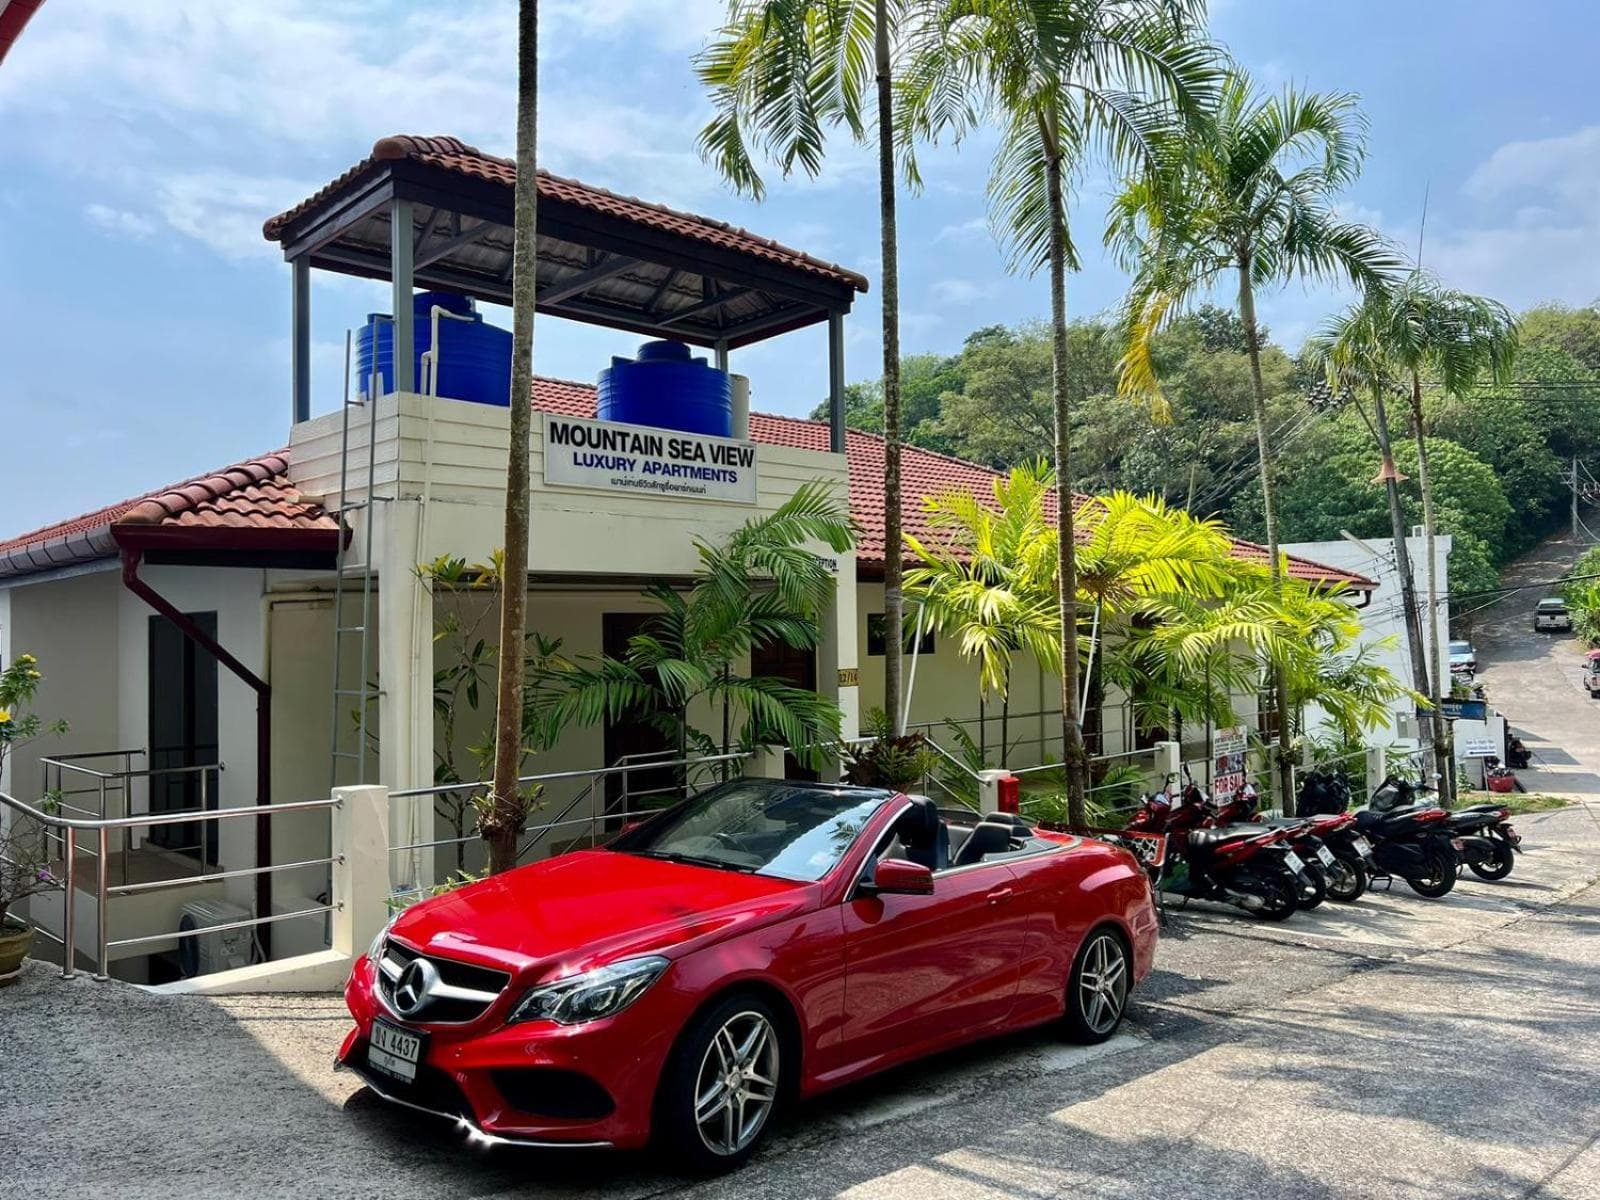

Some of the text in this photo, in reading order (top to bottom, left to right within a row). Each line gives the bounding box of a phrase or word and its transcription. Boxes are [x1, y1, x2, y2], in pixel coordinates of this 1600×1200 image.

[550, 421, 755, 468] MOUNTAIN SEA VIEW
[573, 452, 738, 483] LUXURY APARTMENTS
[1215, 776, 1228, 795] FOR
[390, 1034, 418, 1058] 4437
